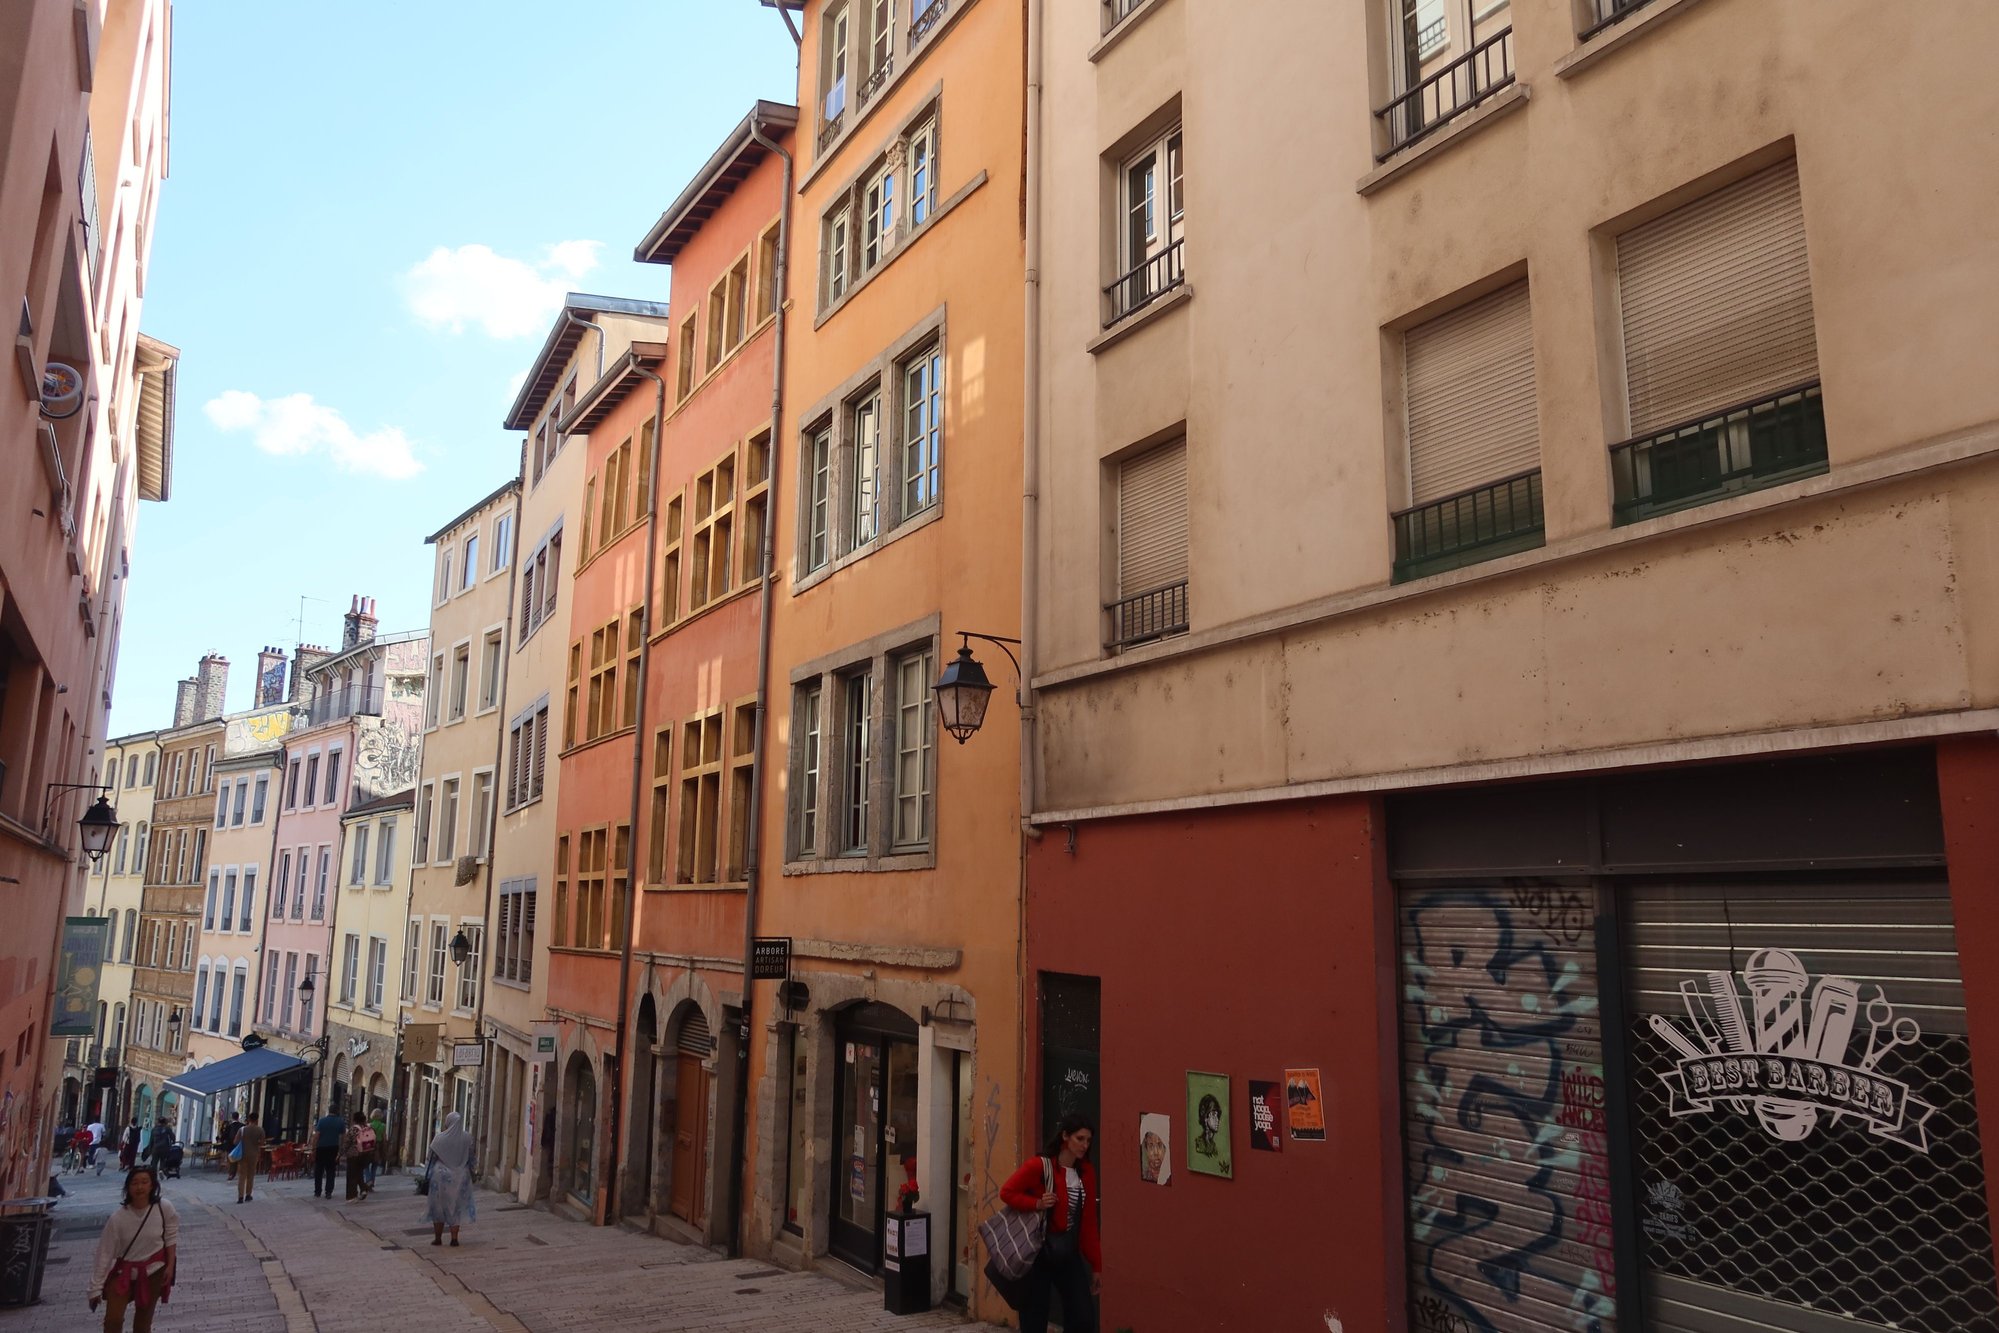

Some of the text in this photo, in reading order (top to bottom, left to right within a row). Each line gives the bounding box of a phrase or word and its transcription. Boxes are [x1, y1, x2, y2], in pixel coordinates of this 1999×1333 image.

[756, 947, 785, 955] ARBORE
[756, 956, 784, 964] ARTISAN
[755, 965, 784, 974] DOREUR
[1690, 1059, 1893, 1116] BEST BARBER
[1253, 1095, 1264, 1105] not
[1254, 1112, 1273, 1122] house
